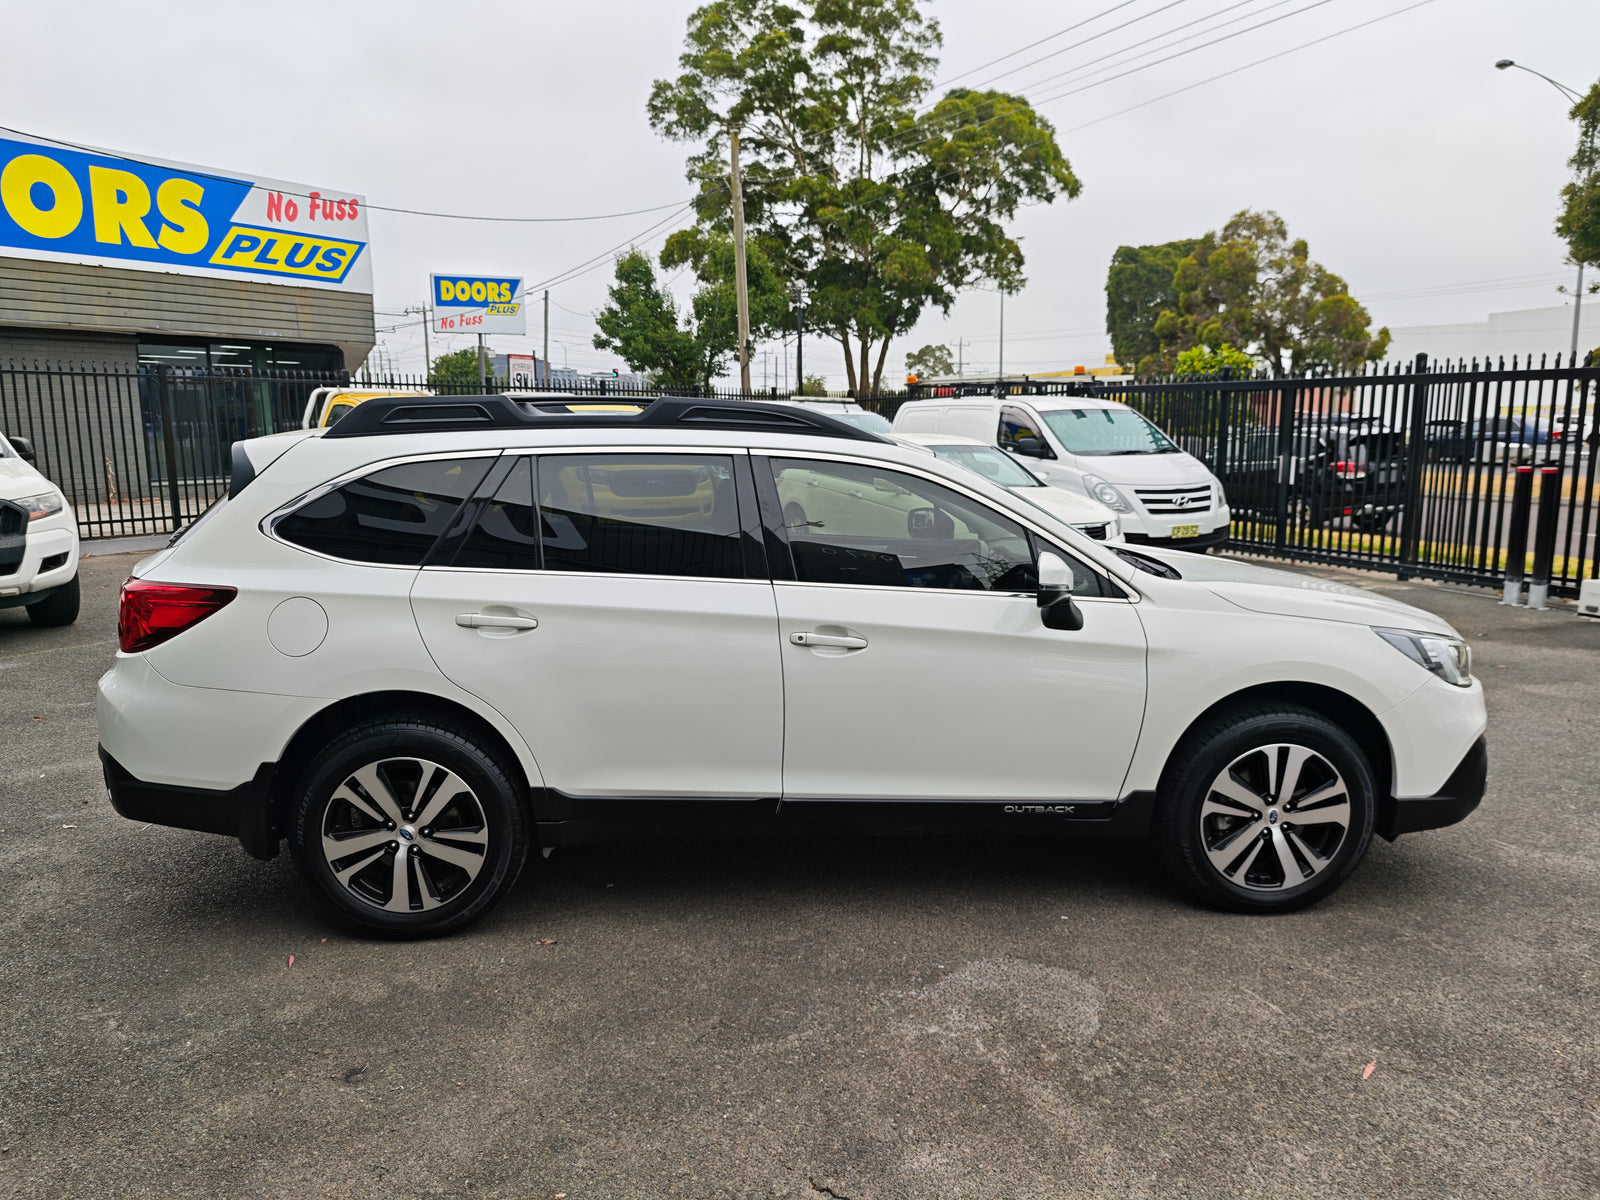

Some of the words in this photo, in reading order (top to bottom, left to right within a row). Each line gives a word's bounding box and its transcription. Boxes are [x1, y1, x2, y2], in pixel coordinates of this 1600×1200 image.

[0, 154, 209, 255] ORS
[266, 191, 298, 223] No
[308, 191, 359, 222] Fuss
[222, 235, 347, 272] PLUS
[440, 280, 512, 302] DOORS
[490, 305, 516, 314] PLUS
[440, 317, 455, 330] No
[459, 313, 484, 327] Fuss
[1003, 805, 1075, 813] OUTBACK
